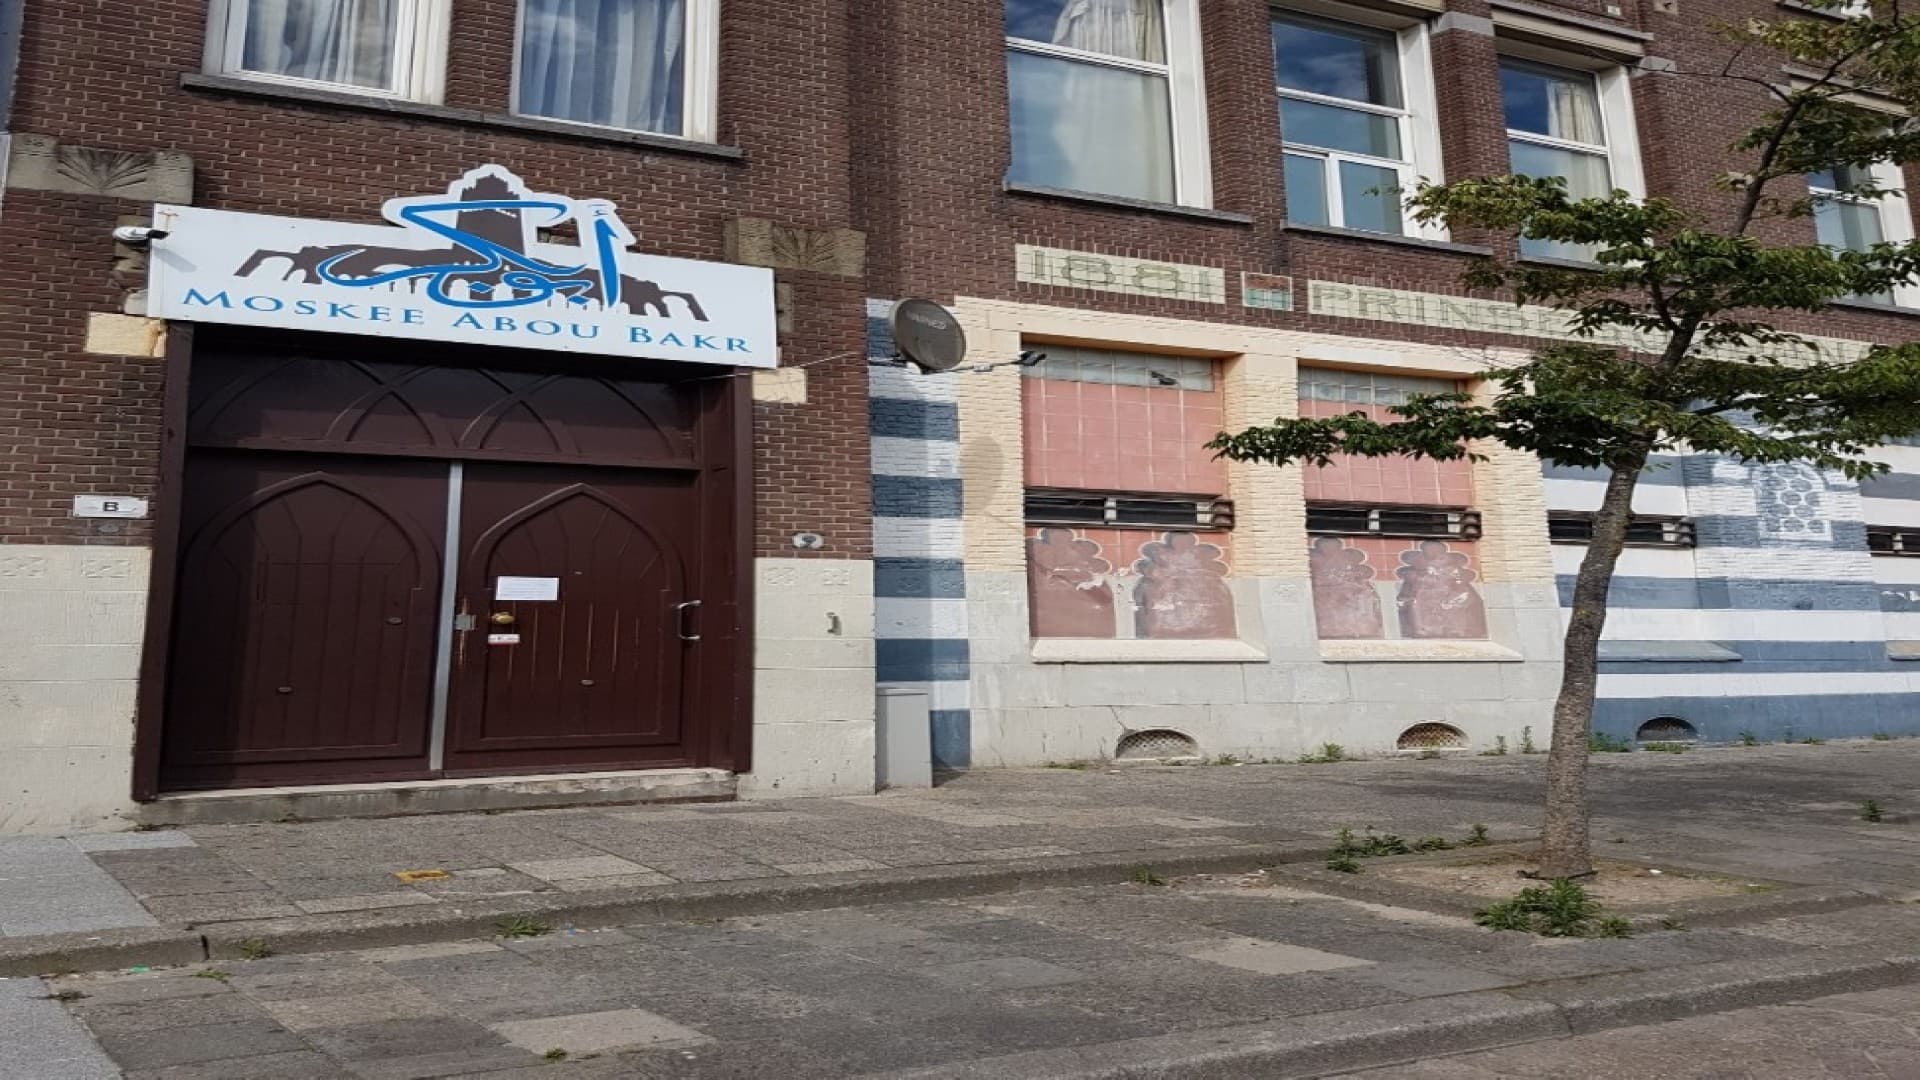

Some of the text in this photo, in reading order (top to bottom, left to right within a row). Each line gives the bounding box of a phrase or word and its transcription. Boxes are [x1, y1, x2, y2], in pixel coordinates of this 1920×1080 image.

[183, 288, 752, 353] MOSKEE ABOU BAKR
[103, 501, 119, 512] B
